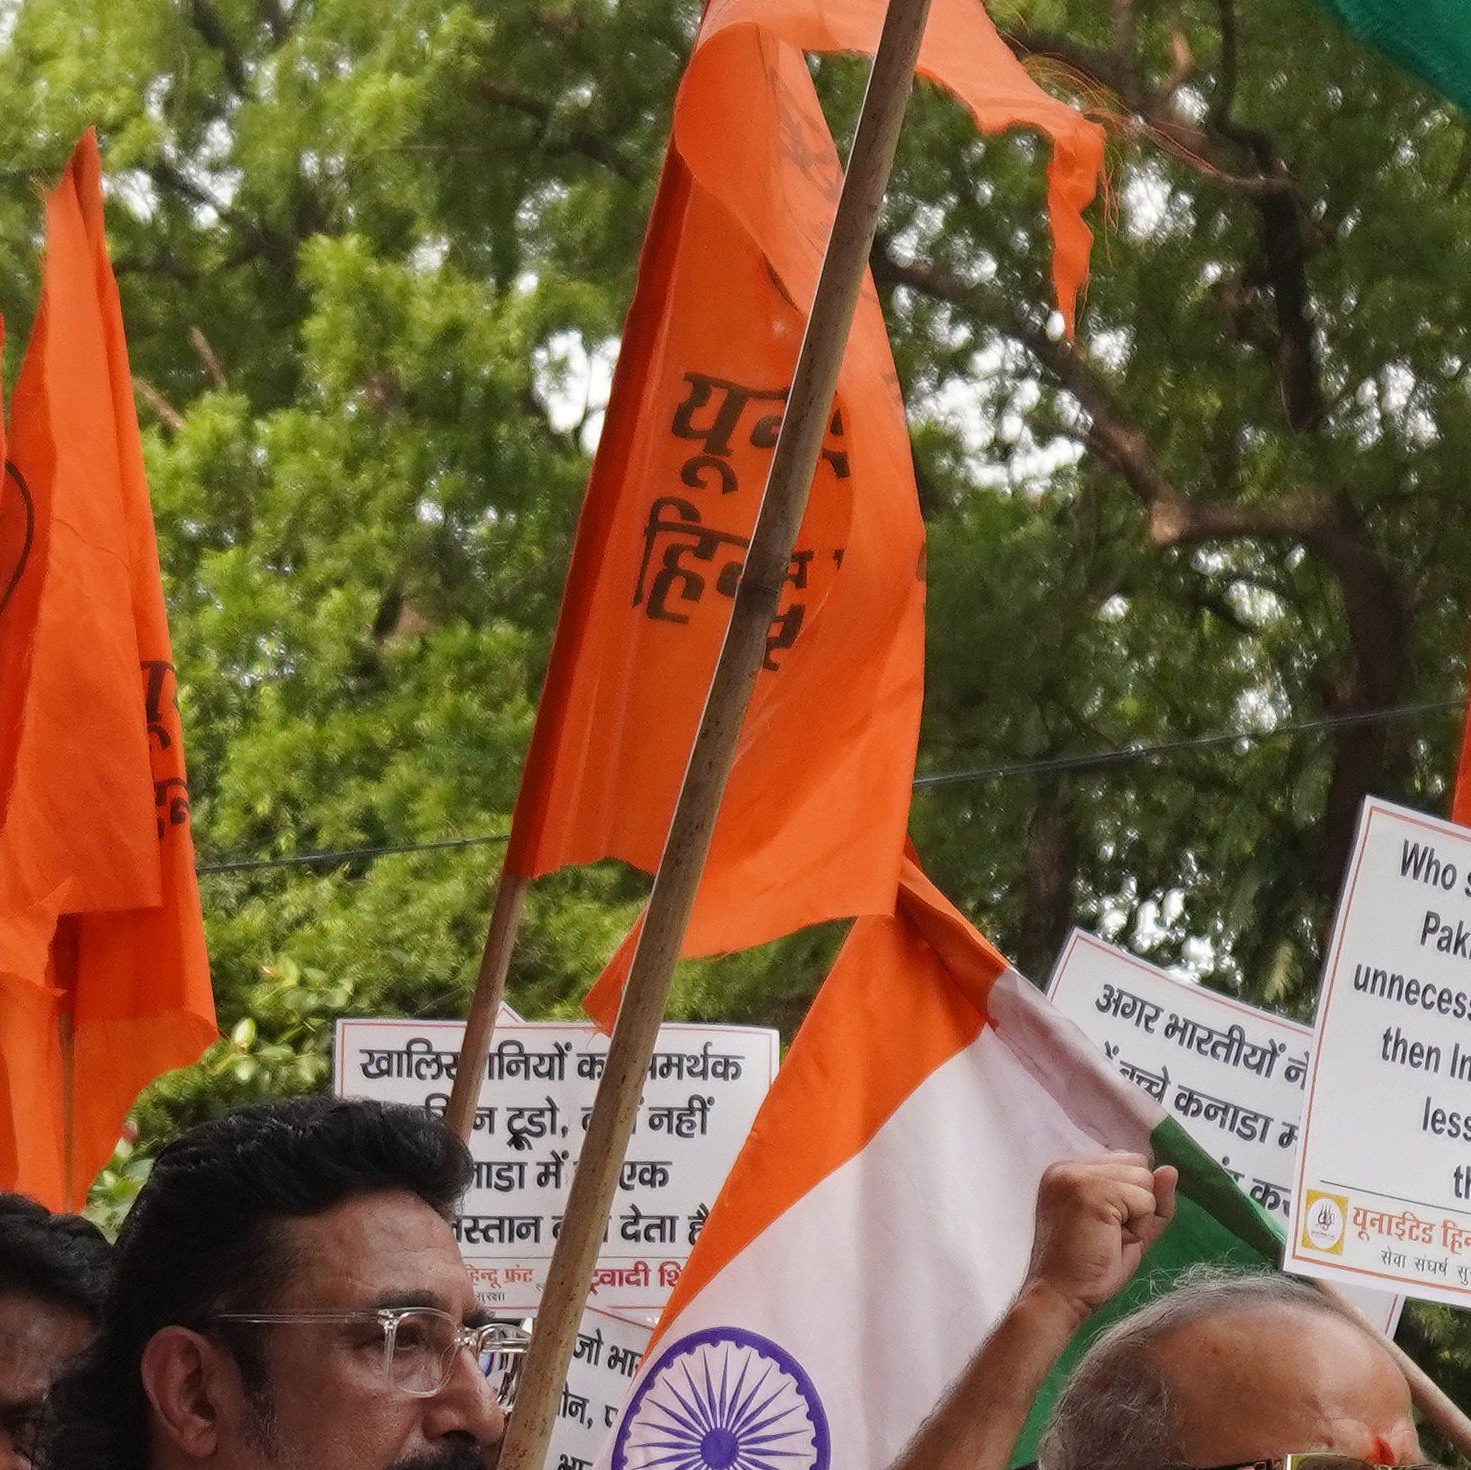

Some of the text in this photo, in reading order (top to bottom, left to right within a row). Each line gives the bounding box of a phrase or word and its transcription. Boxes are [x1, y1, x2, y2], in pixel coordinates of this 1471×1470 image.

[1399, 837, 1458, 893] Who
[1094, 982, 1165, 1035] अगर
[1163, 1023, 1288, 1080] भारतीयों
[1380, 1024, 1442, 1074] then
[647, 1093, 715, 1138] नहीं
[1174, 1080, 1275, 1145] कनाडा
[535, 1150, 569, 1190] में
[619, 1203, 680, 1245] देता
